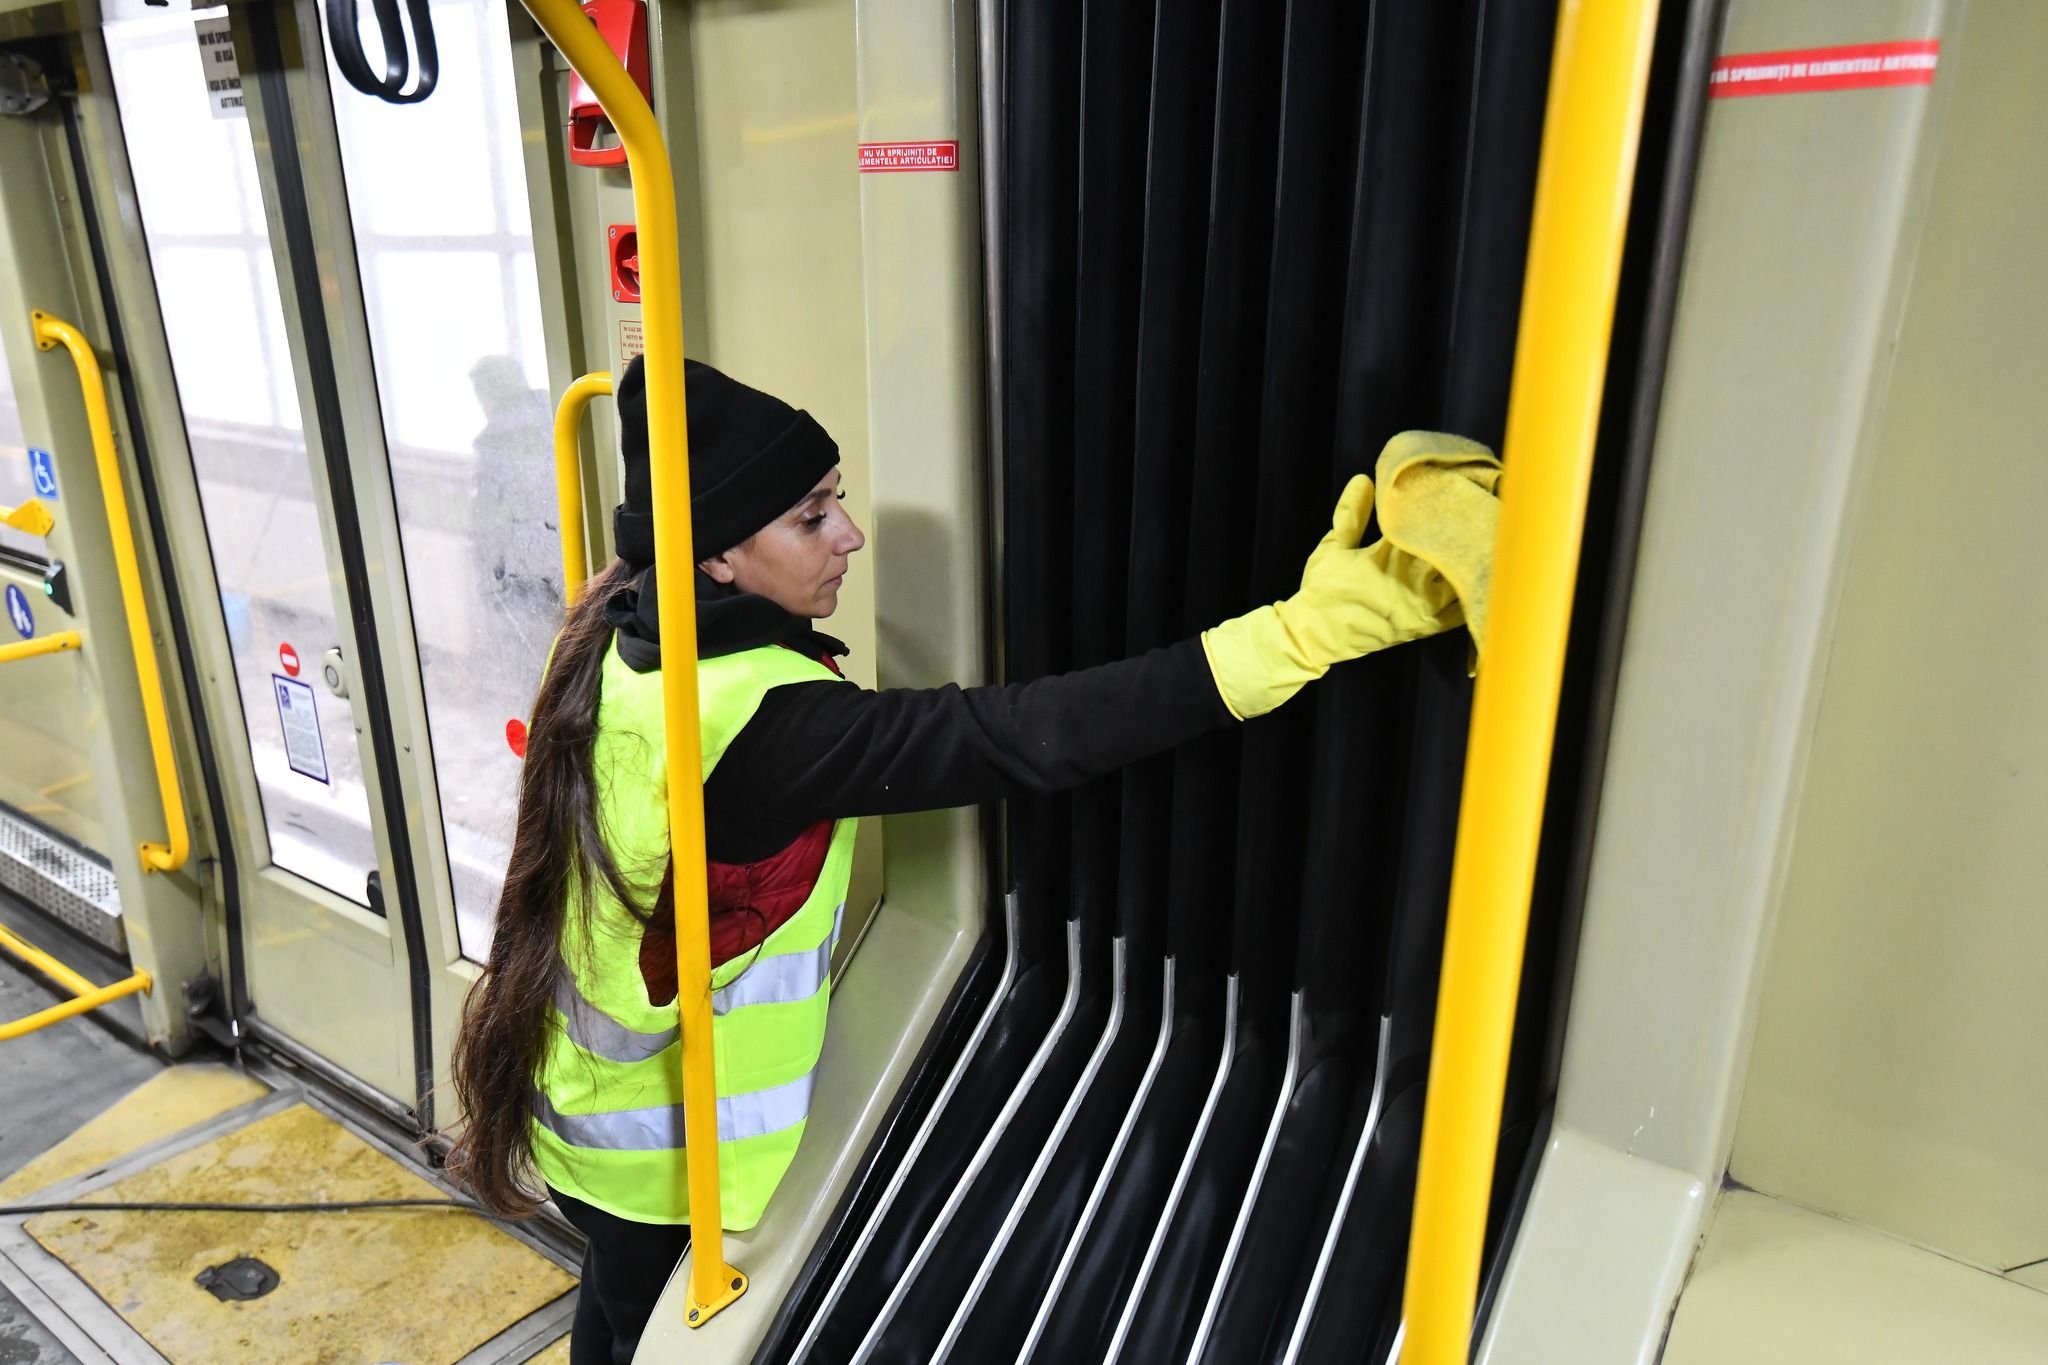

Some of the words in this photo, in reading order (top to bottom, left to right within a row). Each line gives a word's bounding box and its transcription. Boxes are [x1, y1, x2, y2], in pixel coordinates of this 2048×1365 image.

[1791, 63, 1807, 78] DE
[864, 150, 873, 158] NU
[927, 147, 937, 156] DE
